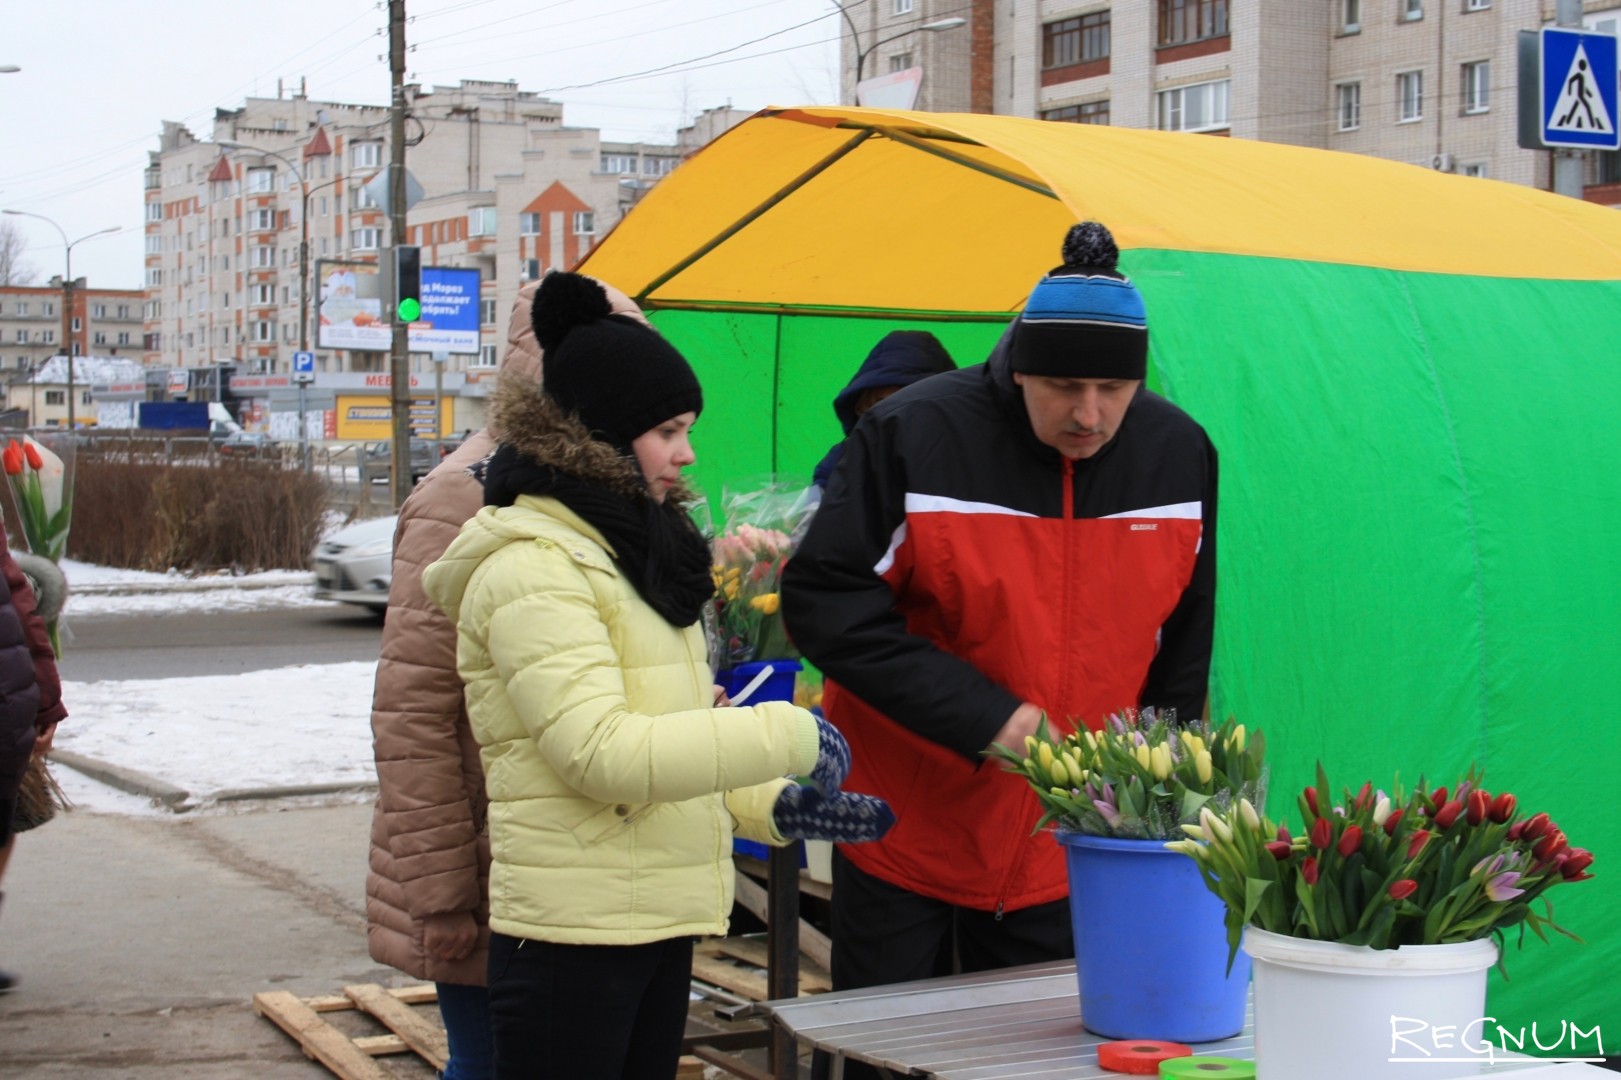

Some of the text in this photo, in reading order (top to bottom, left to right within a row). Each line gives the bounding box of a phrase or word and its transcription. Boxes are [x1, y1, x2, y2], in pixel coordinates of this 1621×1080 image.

[432, 282, 463, 294] Мороз
[422, 295, 471, 304] одолжает
[422, 305, 460, 316] обрять!
[297, 353, 311, 370] P
[366, 375, 418, 386] МЕБЬ
